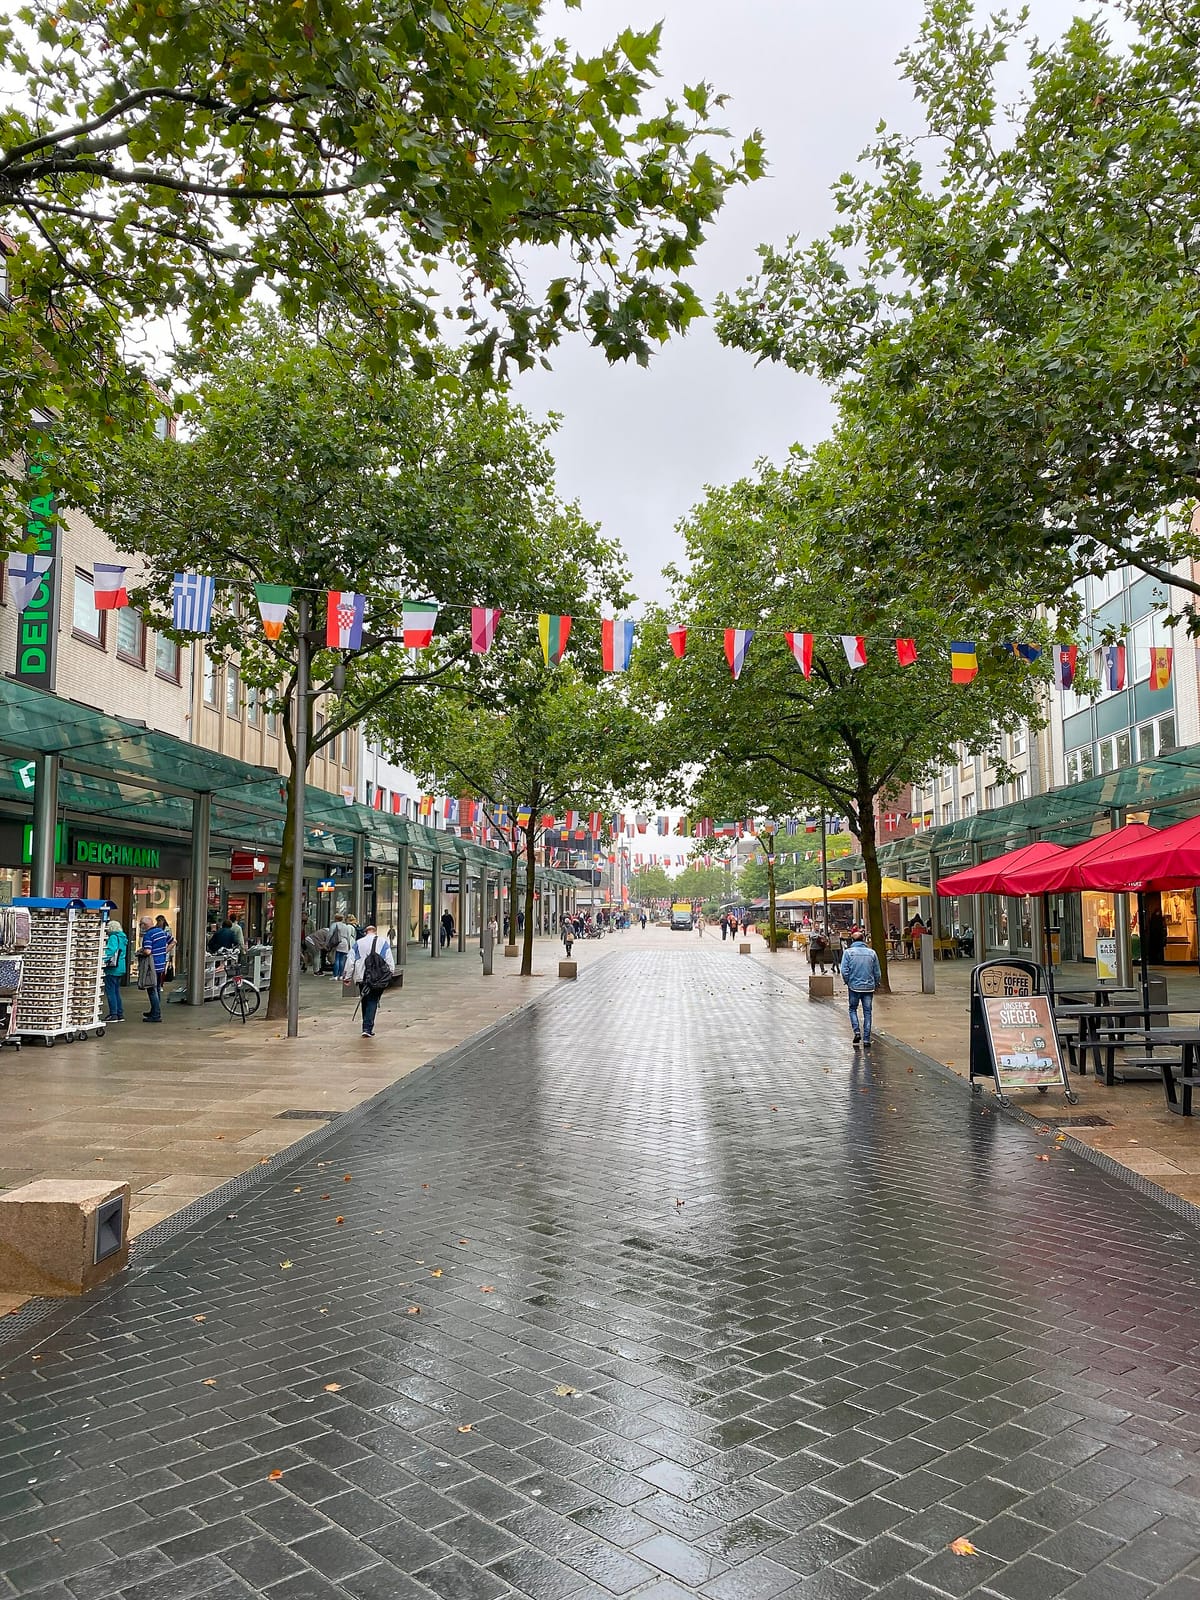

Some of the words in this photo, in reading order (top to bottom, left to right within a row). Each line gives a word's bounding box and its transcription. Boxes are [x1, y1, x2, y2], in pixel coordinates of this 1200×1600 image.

[77, 840, 160, 868] DEICHMANN
[1003, 976, 1029, 988] COFFEE
[1004, 986, 1014, 996] TO
[1019, 987, 1029, 997] GO
[1003, 1001, 1024, 1010] UNSER
[999, 1009, 1038, 1025] SIEGER
